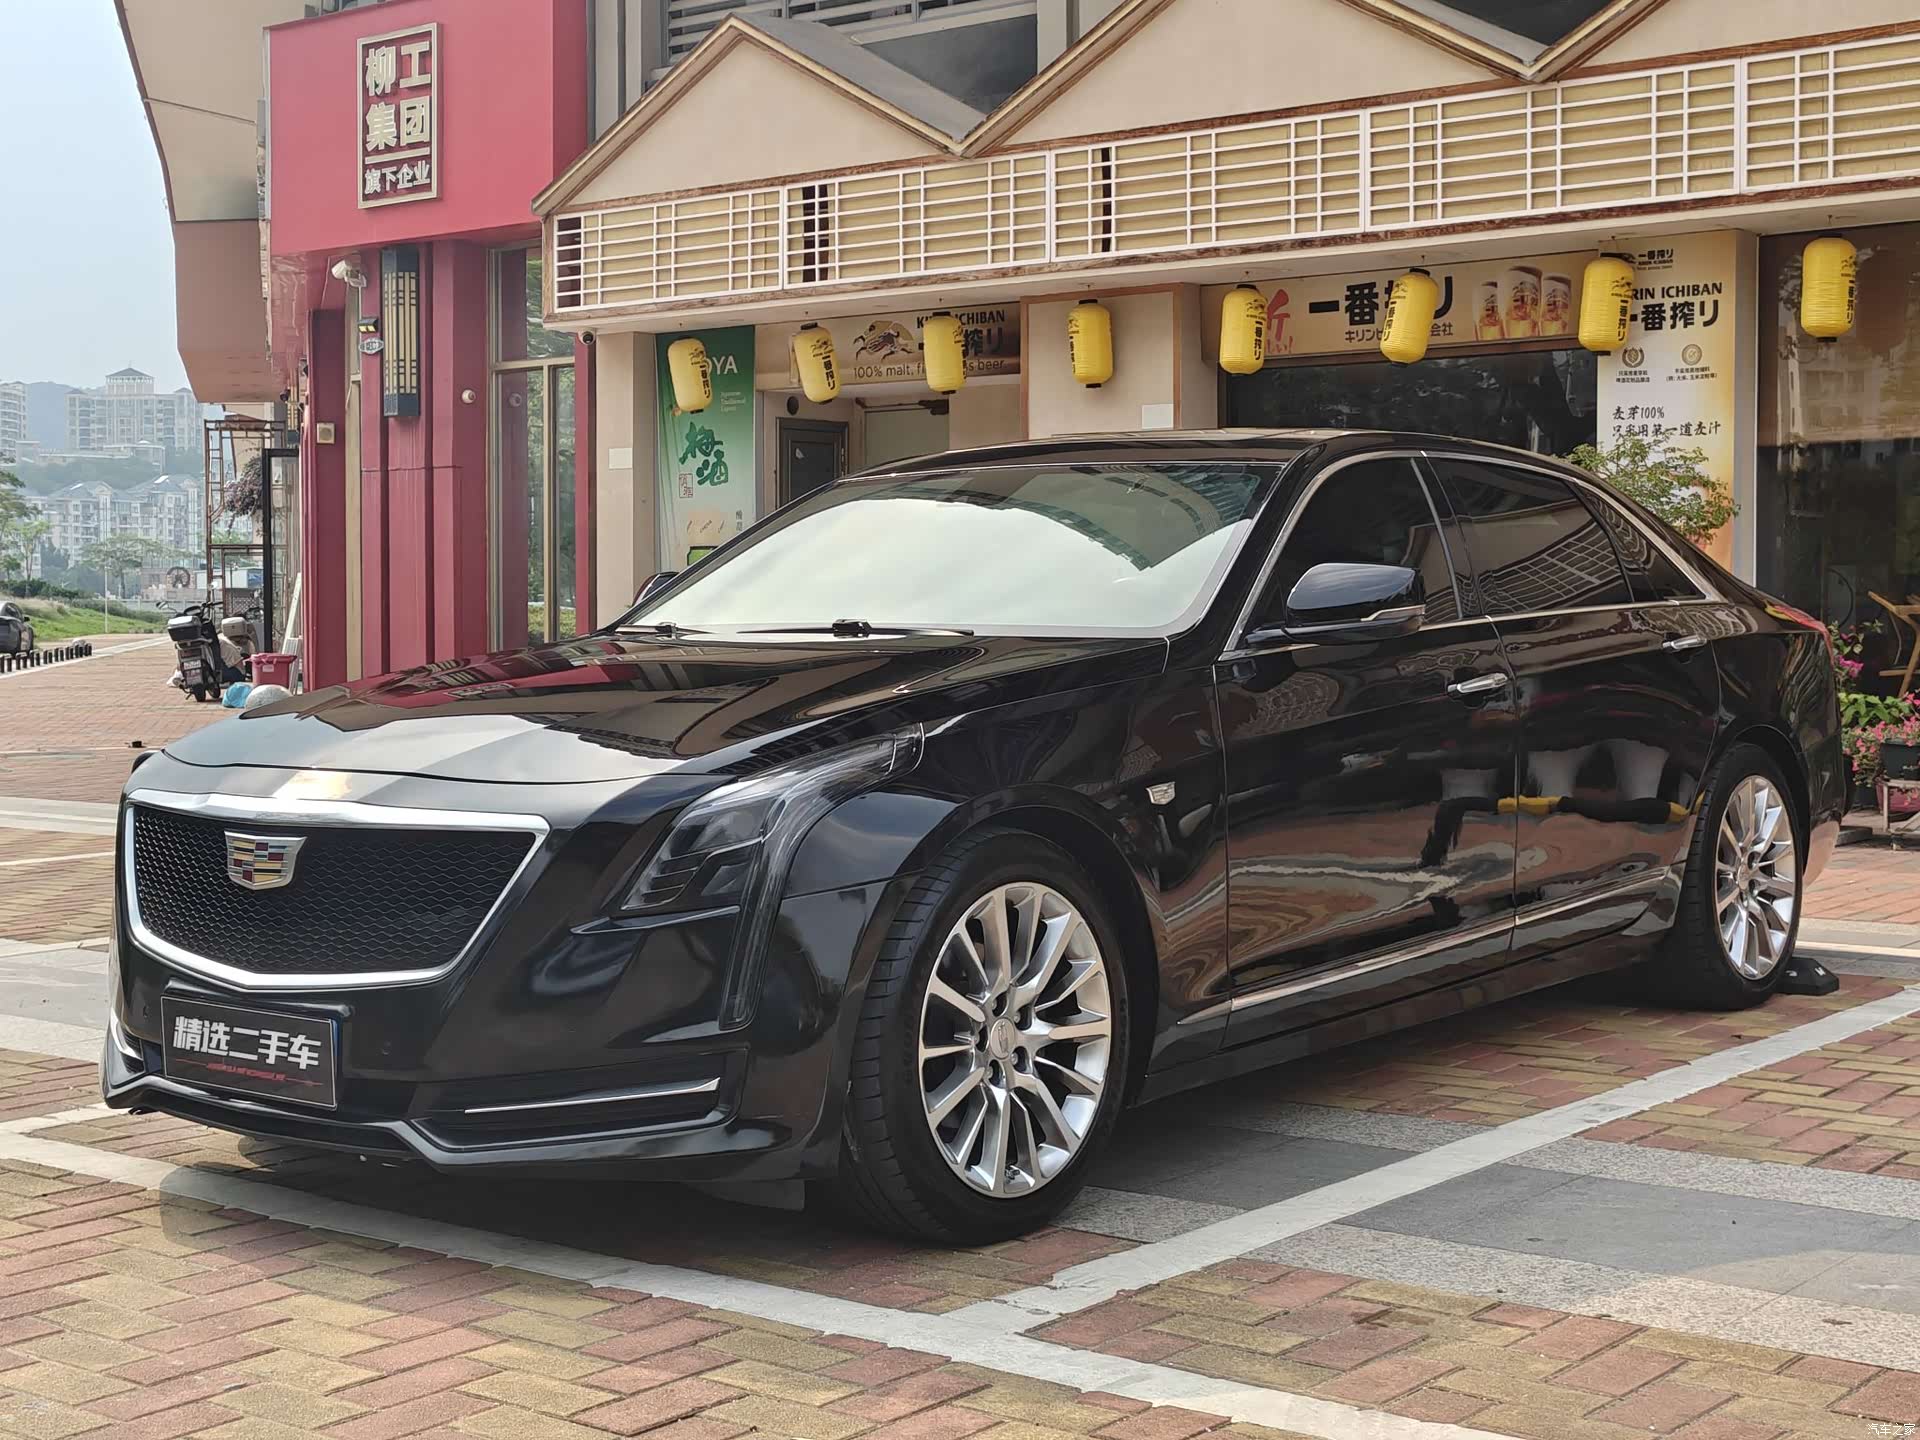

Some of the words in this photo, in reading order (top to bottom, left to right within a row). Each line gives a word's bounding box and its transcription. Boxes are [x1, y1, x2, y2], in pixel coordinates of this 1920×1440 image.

[366, 41, 431, 97] 柳工
[365, 95, 431, 152] 集团
[364, 159, 431, 194] 旗下企业
[1661, 282, 1723, 299] ICHIBAN
[853, 366, 883, 378] 100%
[172, 1015, 322, 1070] 精选二手车
